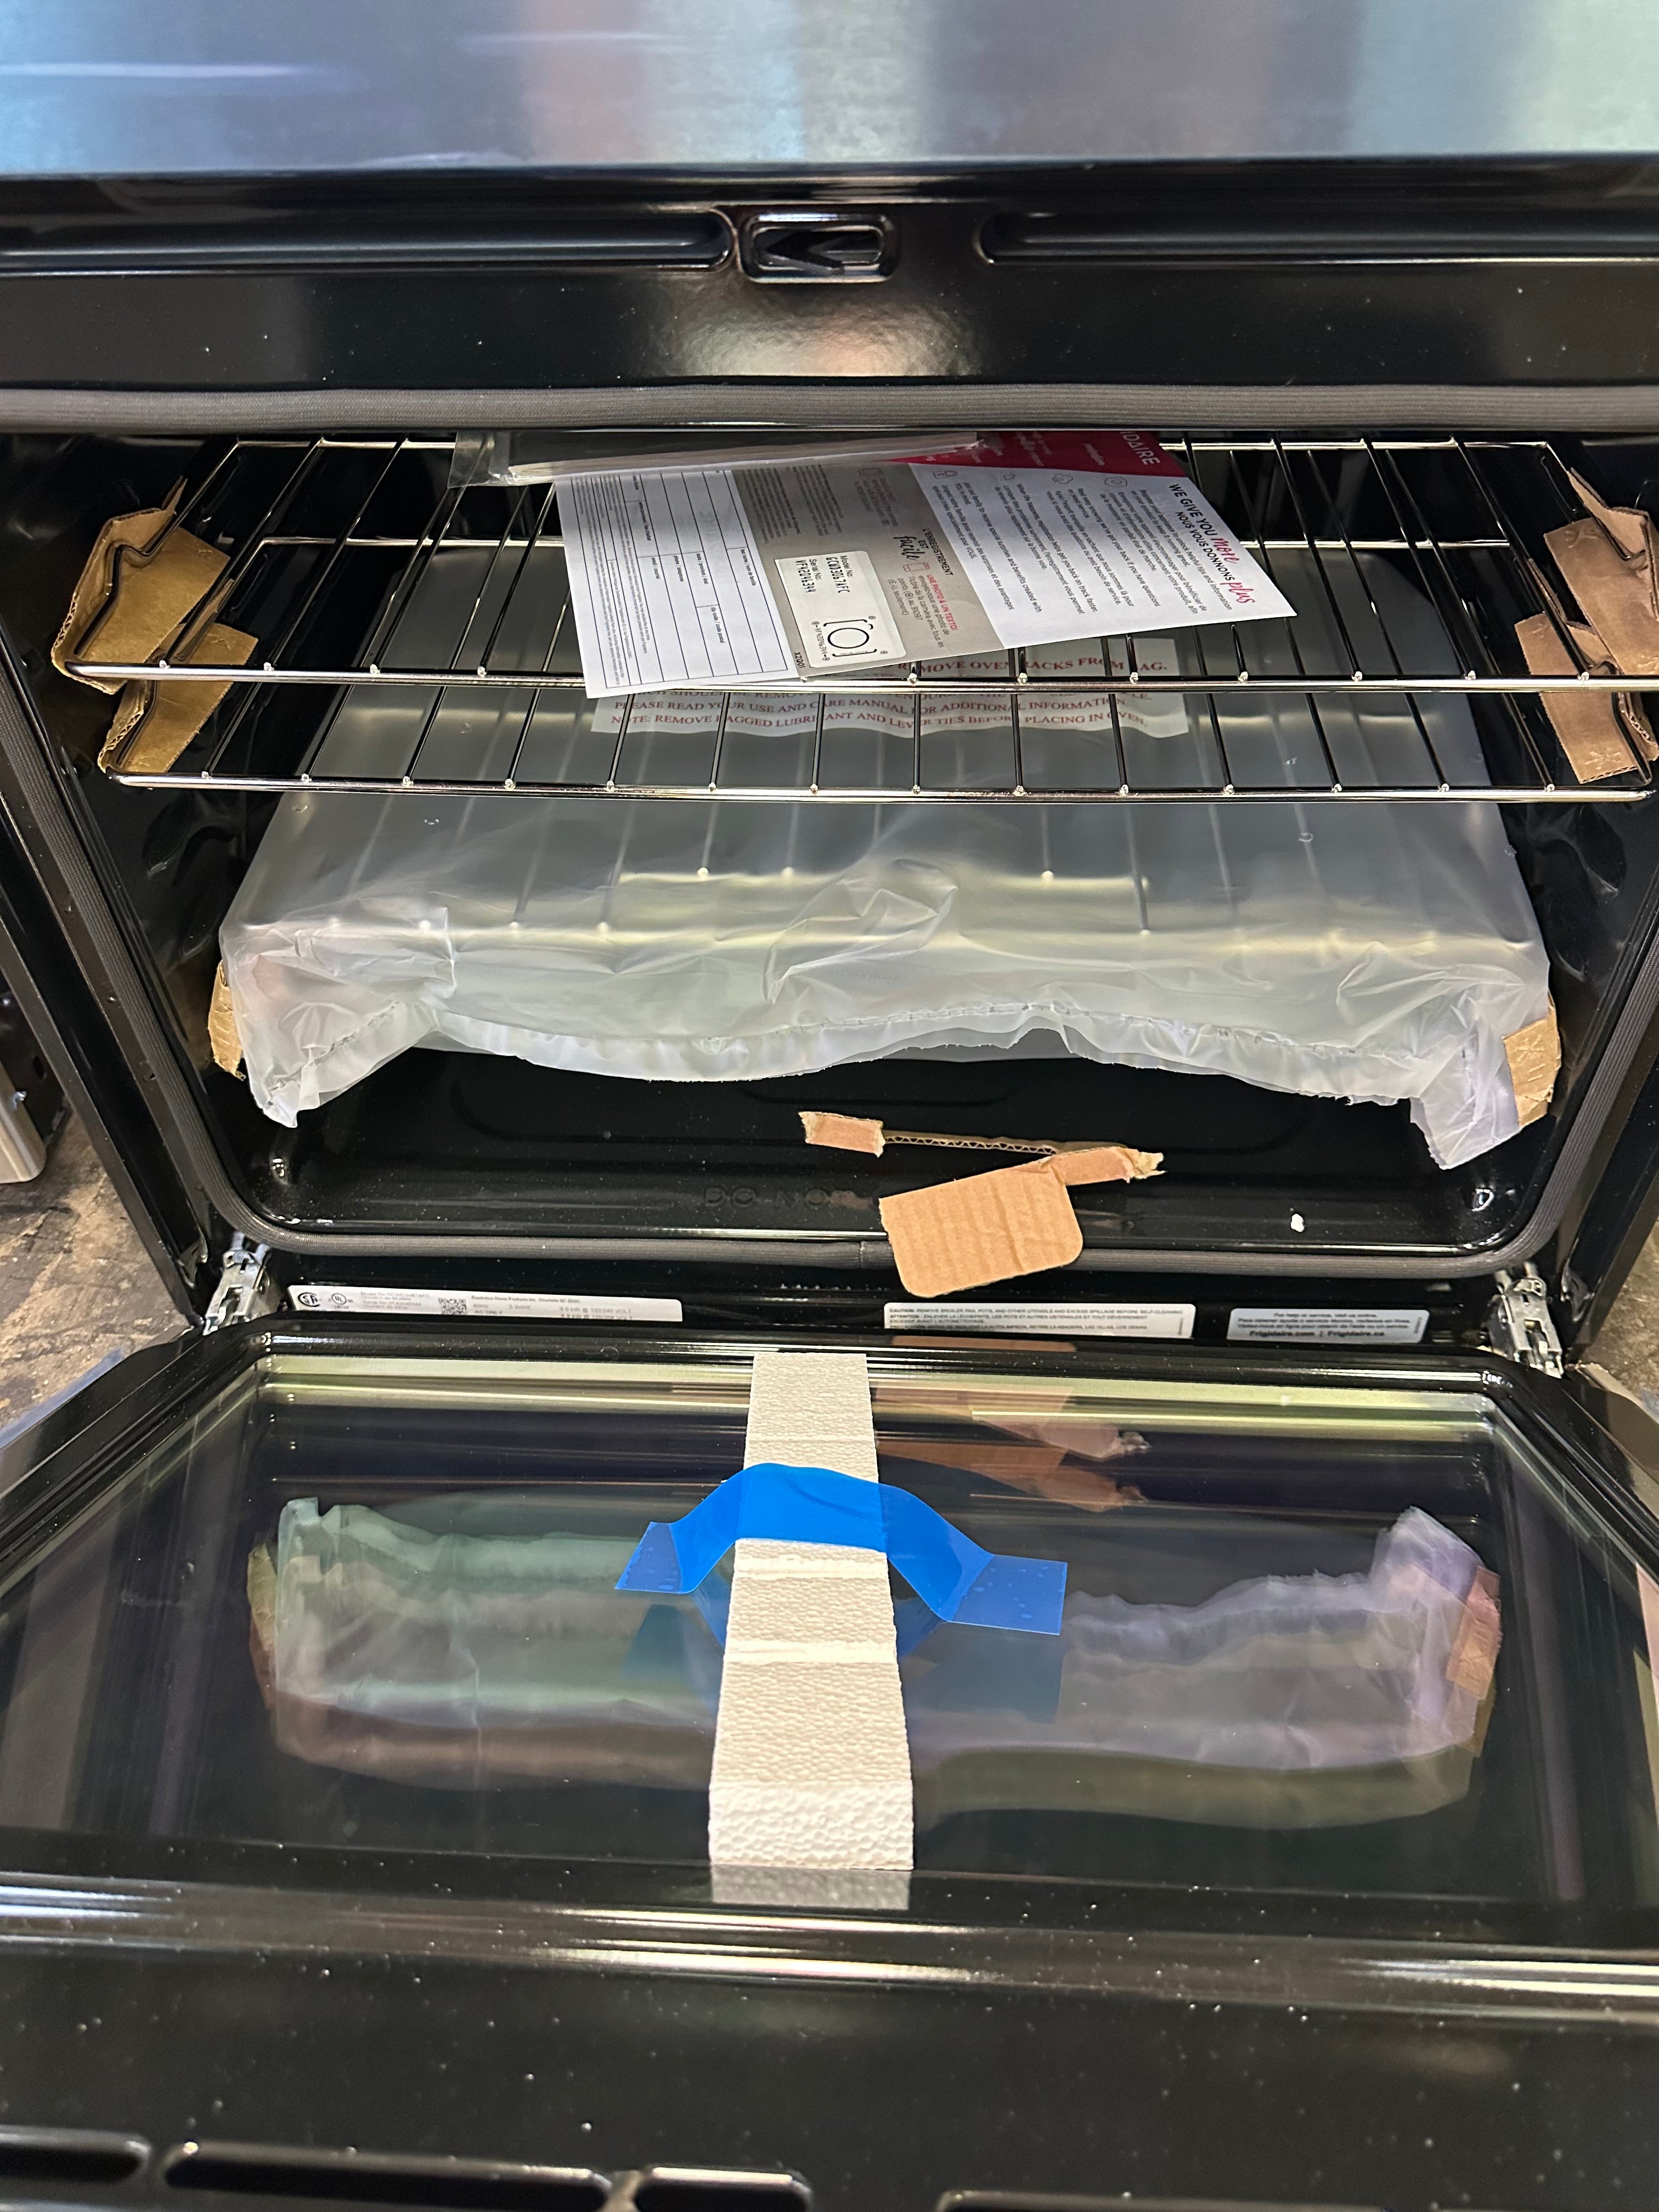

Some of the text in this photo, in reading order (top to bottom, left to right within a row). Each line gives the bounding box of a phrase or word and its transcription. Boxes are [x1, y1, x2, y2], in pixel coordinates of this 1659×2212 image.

[1166, 484, 1244, 563] WE GIVE YOU more
[892, 535, 927, 560] facile
[917, 540, 929, 549] EST
[922, 528, 953, 575] L'ENREGISTREMENT
[1111, 542, 1123, 550] your
[1164, 539, 1182, 554] running
[964, 547, 978, 558] VOUS.
[1119, 551, 1131, 561] back
[1173, 512, 1262, 604] NOUS VOUS DONNONS plus
[808, 559, 820, 571] Serial
[839, 555, 852, 569] Model
[794, 560, 817, 592] VF42046344
[995, 541, 1012, 557] surprises
[1011, 567, 1028, 584] benefits
[1020, 584, 1037, 601] created
[1030, 601, 1043, 612] with
[1067, 568, 1080, 578] back
[1127, 566, 1139, 574] you
[926, 574, 937, 583] UNE
[978, 555, 995, 573] surprises
[996, 588, 1014, 610] avantages
[1093, 566, 1108, 580] besoin
[1106, 588, 1123, 605] service.
[1101, 562, 1111, 571] nous
[1107, 572, 1124, 590] sommes
[1121, 596, 1135, 606] pour
[1135, 574, 1147, 584] have
[1166, 575, 1178, 586] votre
[1184, 552, 1201, 566] helpful
[1195, 566, 1207, 574] tips
[1209, 584, 1234, 610] information
[916, 575, 936, 603] envoyez-nous
[930, 584, 944, 599] PHOTO
[1077, 586, 1092, 597] track
[1173, 572, 1186, 581] pour
[1182, 582, 1204, 603] bénéficier
[892, 591, 910, 616] seulement)
[896, 578, 910, 590] points
[910, 606, 923, 620] 91097
[1063, 586, 1074, 596] vous
[1069, 597, 1085, 614] permet
[1140, 585, 1161, 607] questions
[930, 604, 940, 613] une
[1084, 598, 1101, 612] faster.
[918, 601, 933, 618] caméra
[926, 619, 936, 629] avec
[931, 630, 942, 641] tous
[934, 614, 948, 629] photo
[944, 613, 959, 630] TEXTO!
[716, 633, 725, 643] postal
[793, 652, 805, 668] XZQ01
[898, 660, 964, 673] RMOVE
[1137, 662, 1167, 671] AG.
[667, 702, 704, 710] READ
[749, 704, 775, 713] USE
[778, 703, 806, 713] AND
[849, 699, 908, 714] MANUAL
[612, 715, 651, 724] NTE:
[656, 715, 712, 724] REMOVE
[776, 713, 853, 727] LUBRIANT
[857, 713, 887, 723] AND
[938, 716, 964, 725] TIES
[1089, 713, 1103, 723] IN
